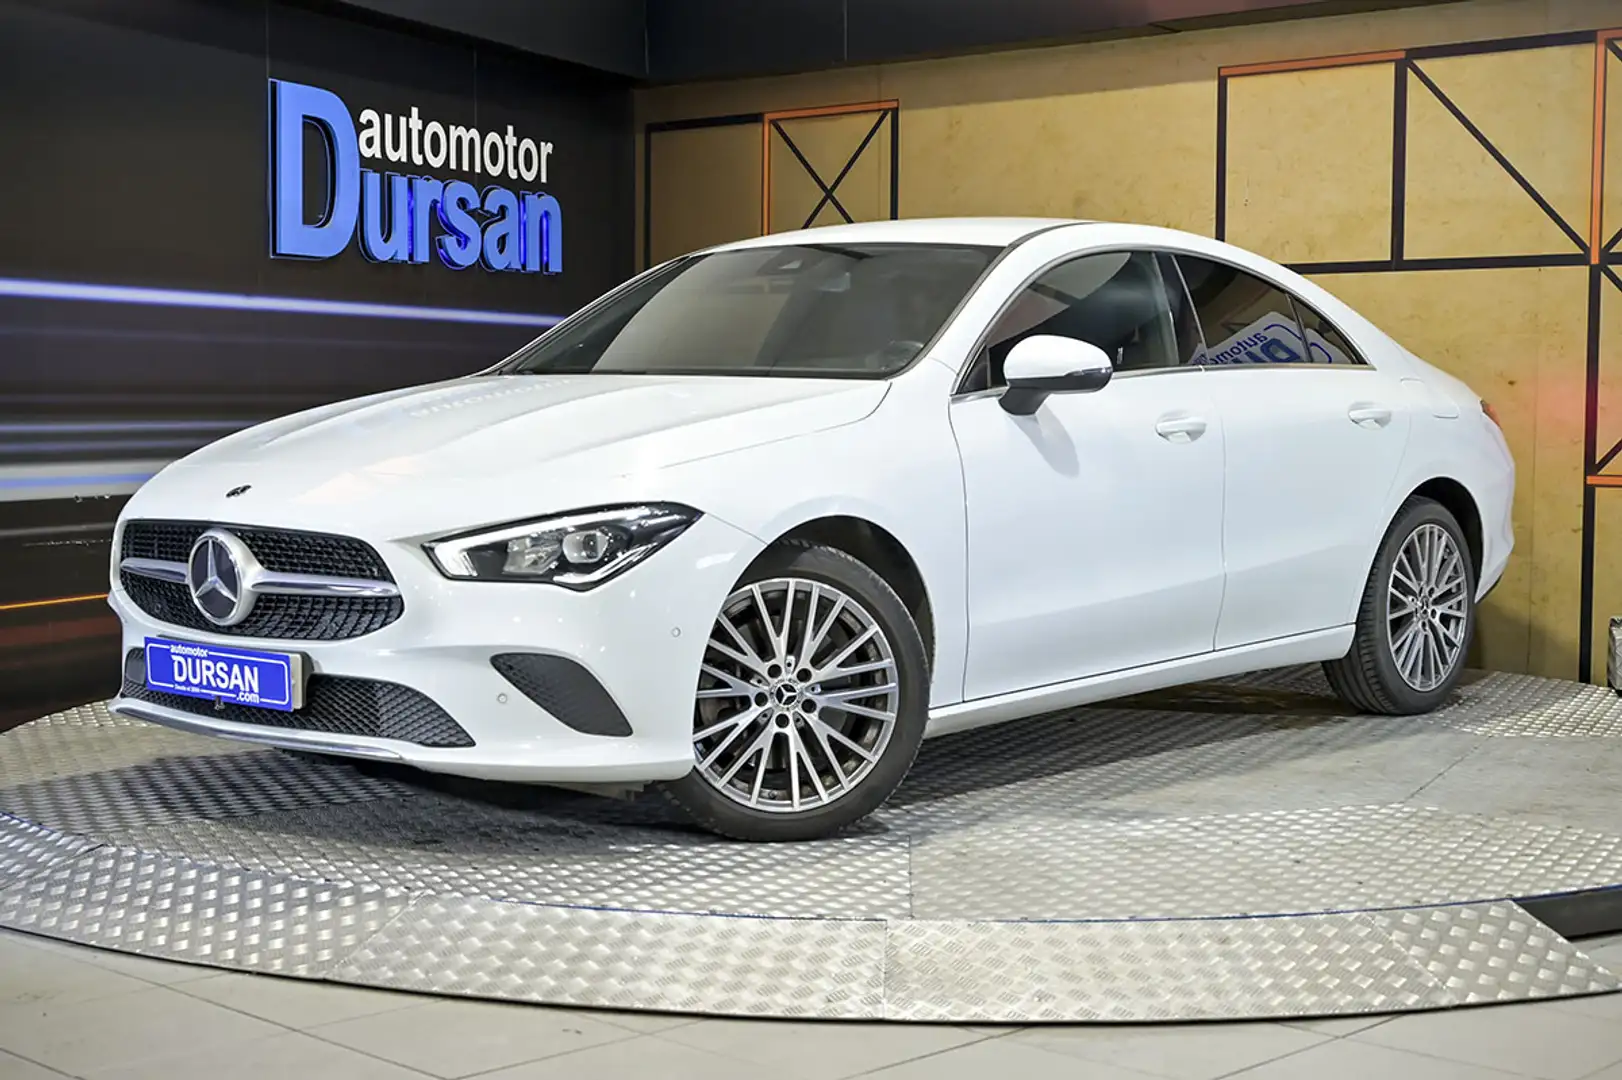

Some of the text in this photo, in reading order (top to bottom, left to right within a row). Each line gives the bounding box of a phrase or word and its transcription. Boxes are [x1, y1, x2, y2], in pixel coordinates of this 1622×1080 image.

[358, 106, 553, 183] automotor
[268, 78, 563, 274] Dursan
[170, 644, 208, 657] automotor
[171, 655, 259, 692] DURSAN
[236, 692, 260, 704] .com
